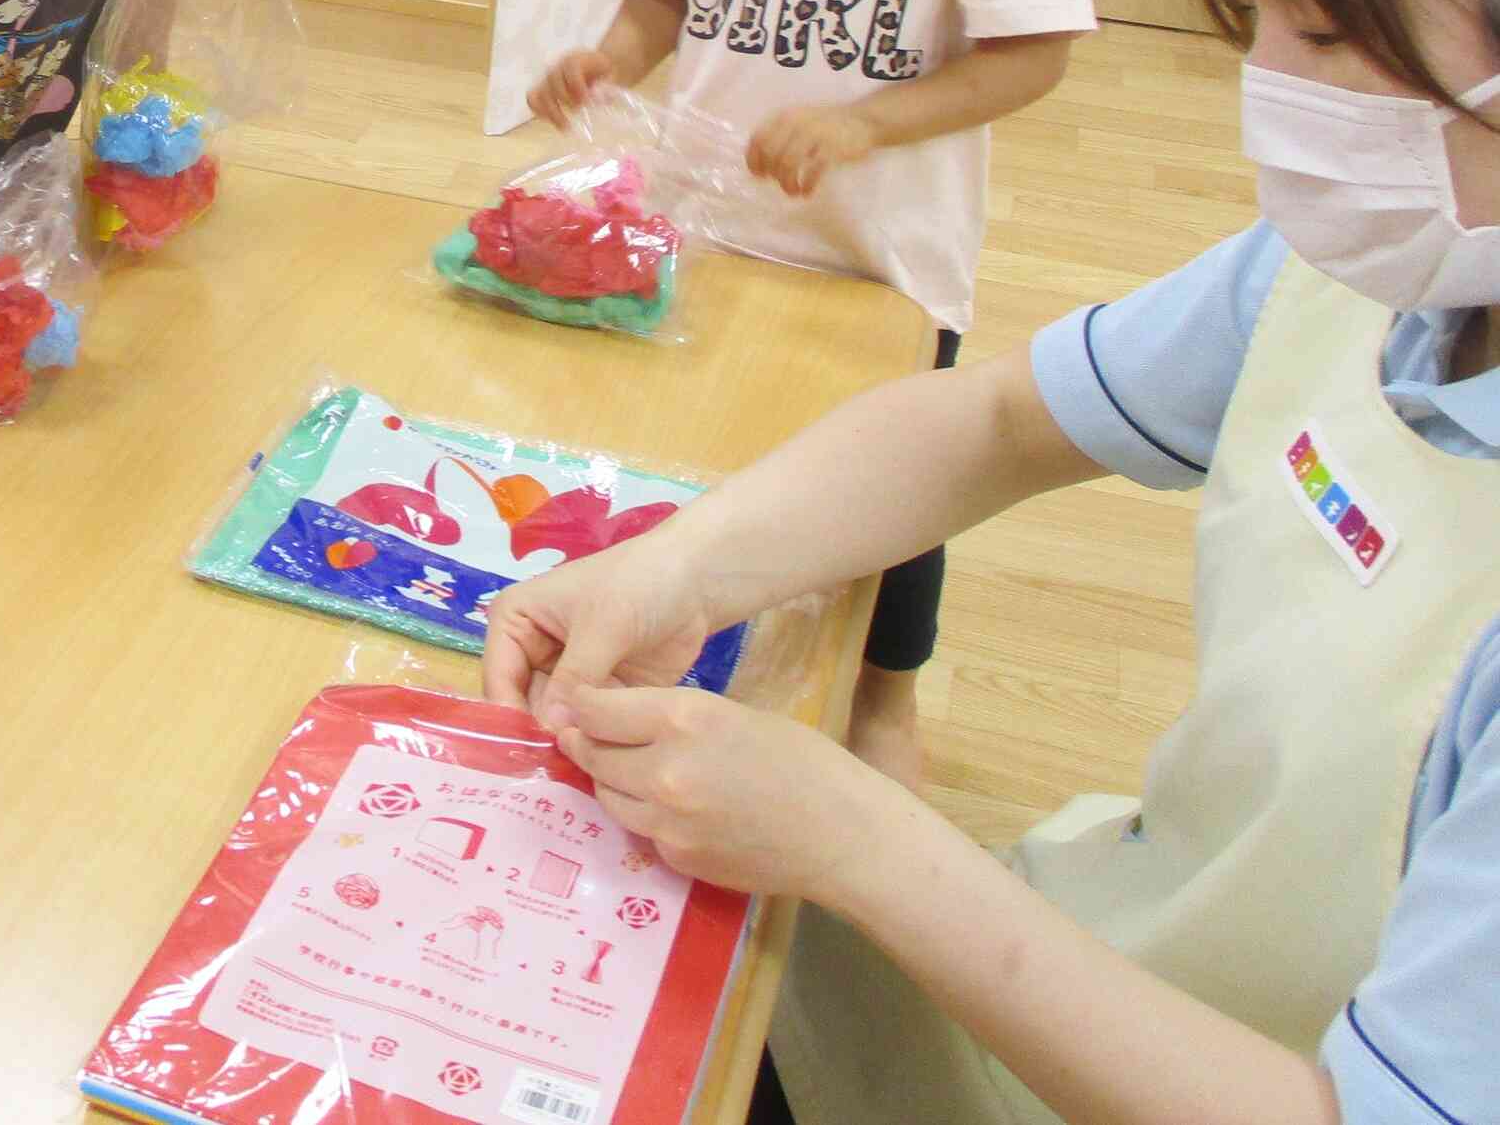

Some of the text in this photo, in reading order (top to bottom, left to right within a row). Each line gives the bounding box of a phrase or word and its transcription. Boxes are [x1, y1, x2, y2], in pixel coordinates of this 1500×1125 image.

[435, 781, 605, 839] おはなの作り方
[506, 866, 522, 882] 2
[297, 886, 311, 899] 5
[423, 932, 437, 944] 4
[551, 960, 566, 975] 3
